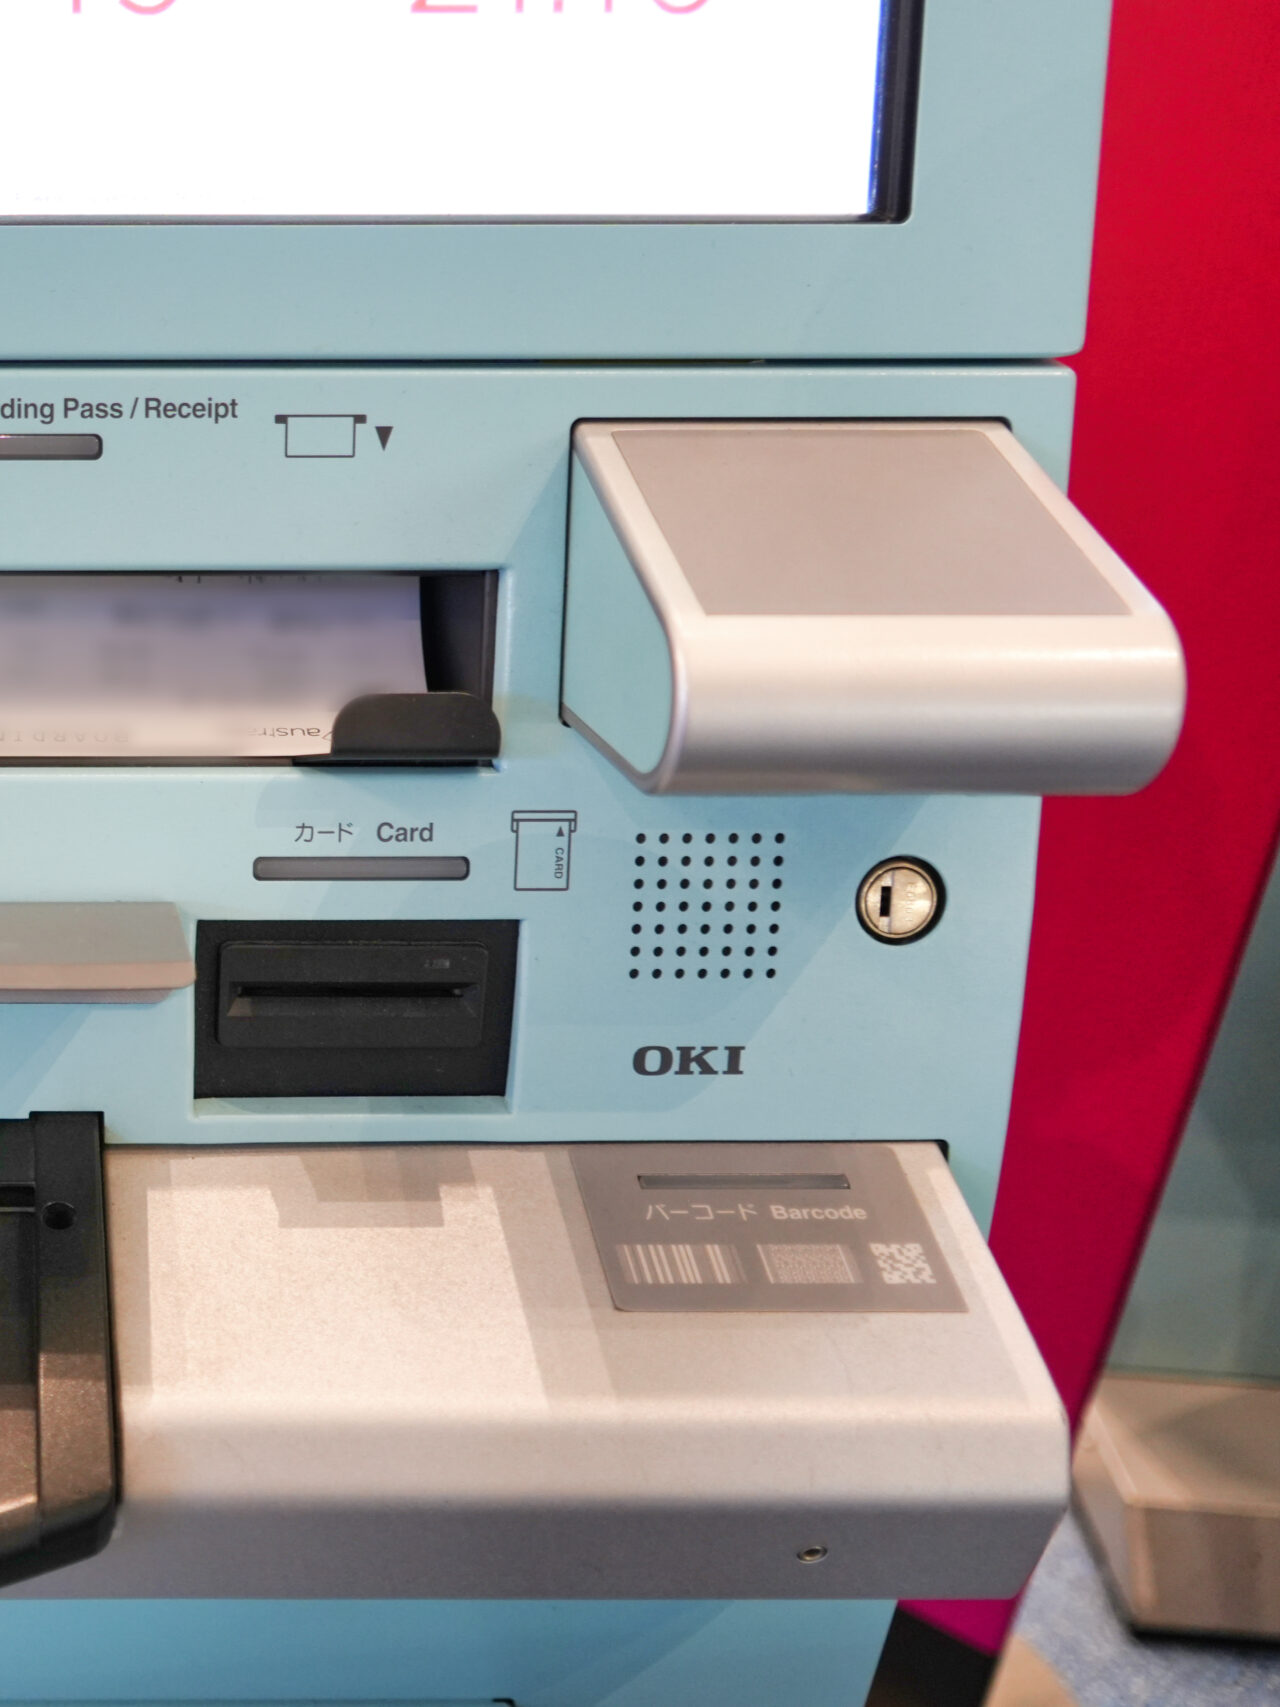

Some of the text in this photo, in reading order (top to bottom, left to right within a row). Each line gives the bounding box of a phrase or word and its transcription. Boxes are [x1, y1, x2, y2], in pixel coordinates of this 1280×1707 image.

[63, 397, 124, 419] Pass
[144, 397, 239, 425] Receipt
[294, 822, 354, 843] カード
[376, 822, 435, 843] Card
[553, 847, 565, 879] CARD
[632, 1045, 746, 1077] OKI
[646, 1204, 758, 1221] バーコード
[769, 1204, 868, 1221] Barcode
